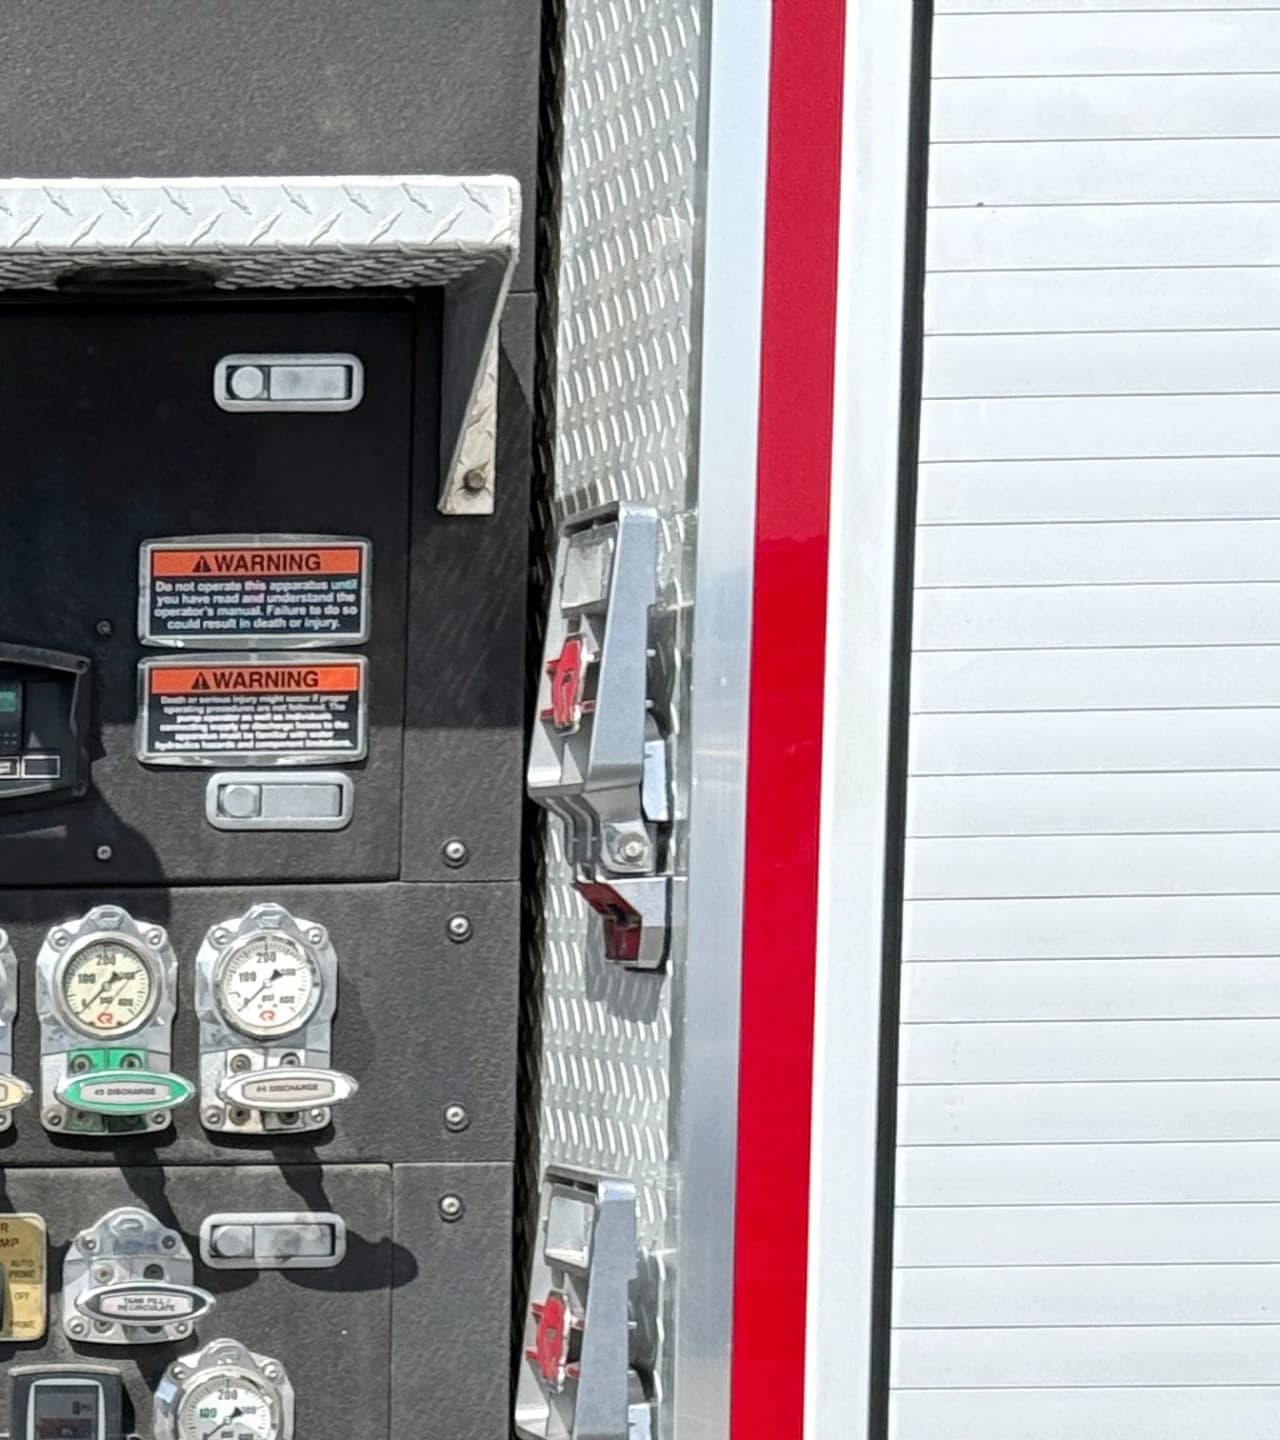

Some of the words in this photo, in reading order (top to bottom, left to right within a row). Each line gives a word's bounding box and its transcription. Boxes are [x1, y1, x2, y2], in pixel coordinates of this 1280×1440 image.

[214, 553, 321, 572] WARNING
[155, 581, 173, 592] Do
[175, 581, 194, 592] not
[197, 582, 241, 594] operate
[244, 580, 266, 591] this
[269, 581, 328, 593] apparatus
[331, 579, 358, 590] until
[157, 595, 179, 606] you
[182, 594, 211, 604] have
[213, 593, 239, 604] read
[242, 593, 265, 603] and
[267, 592, 334, 603] understand
[336, 592, 356, 602] the
[154, 607, 214, 617] operator's
[217, 606, 264, 616] manual.
[266, 605, 307, 616] Failure
[309, 605, 322, 615] to
[324, 605, 340, 615] do
[342, 606, 357, 615] so
[167, 619, 200, 629] could
[203, 619, 236, 629] result
[239, 618, 251, 628] in
[253, 618, 286, 628] death
[290, 618, 301, 628] or
[304, 618, 340, 630] injury.
[212, 671, 319, 688] WARNING
[96, 954, 116, 966] 200
[256, 951, 276, 963] 200
[77, 973, 96, 984] 100
[239, 971, 257, 982] 100
[107, 1087, 156, 1096] DISCHARGE
[269, 1083, 318, 1092] DISCHARGE
[118, 1304, 176, 1312] RECIRCULATE
[217, 1389, 238, 1401] 200
[199, 1406, 218, 1419] 100
